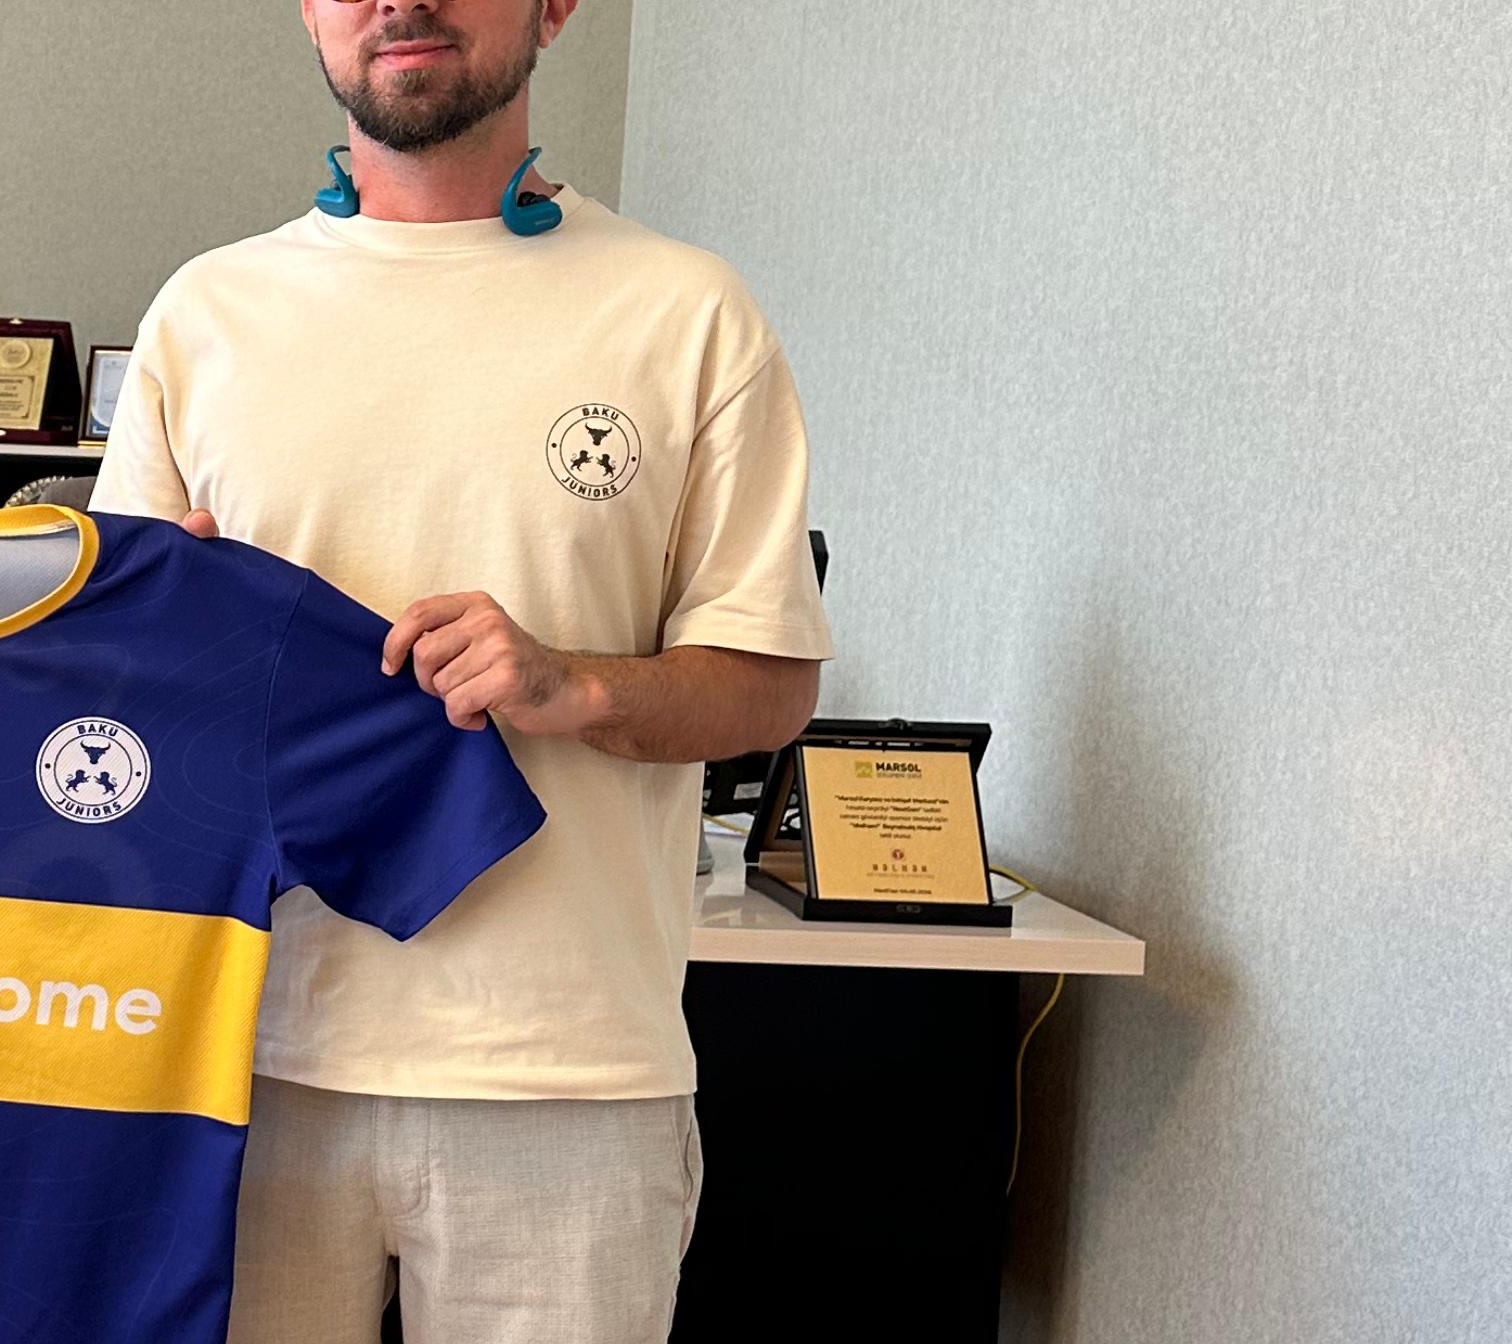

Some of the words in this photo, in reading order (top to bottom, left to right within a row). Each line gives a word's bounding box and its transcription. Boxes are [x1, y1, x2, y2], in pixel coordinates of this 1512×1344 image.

[582, 407, 619, 421] BAKU
[561, 476, 618, 498] JUNIORS
[77, 723, 119, 737] BAKU
[875, 762, 921, 773] MARSOL
[56, 798, 122, 817] JUNIORS
